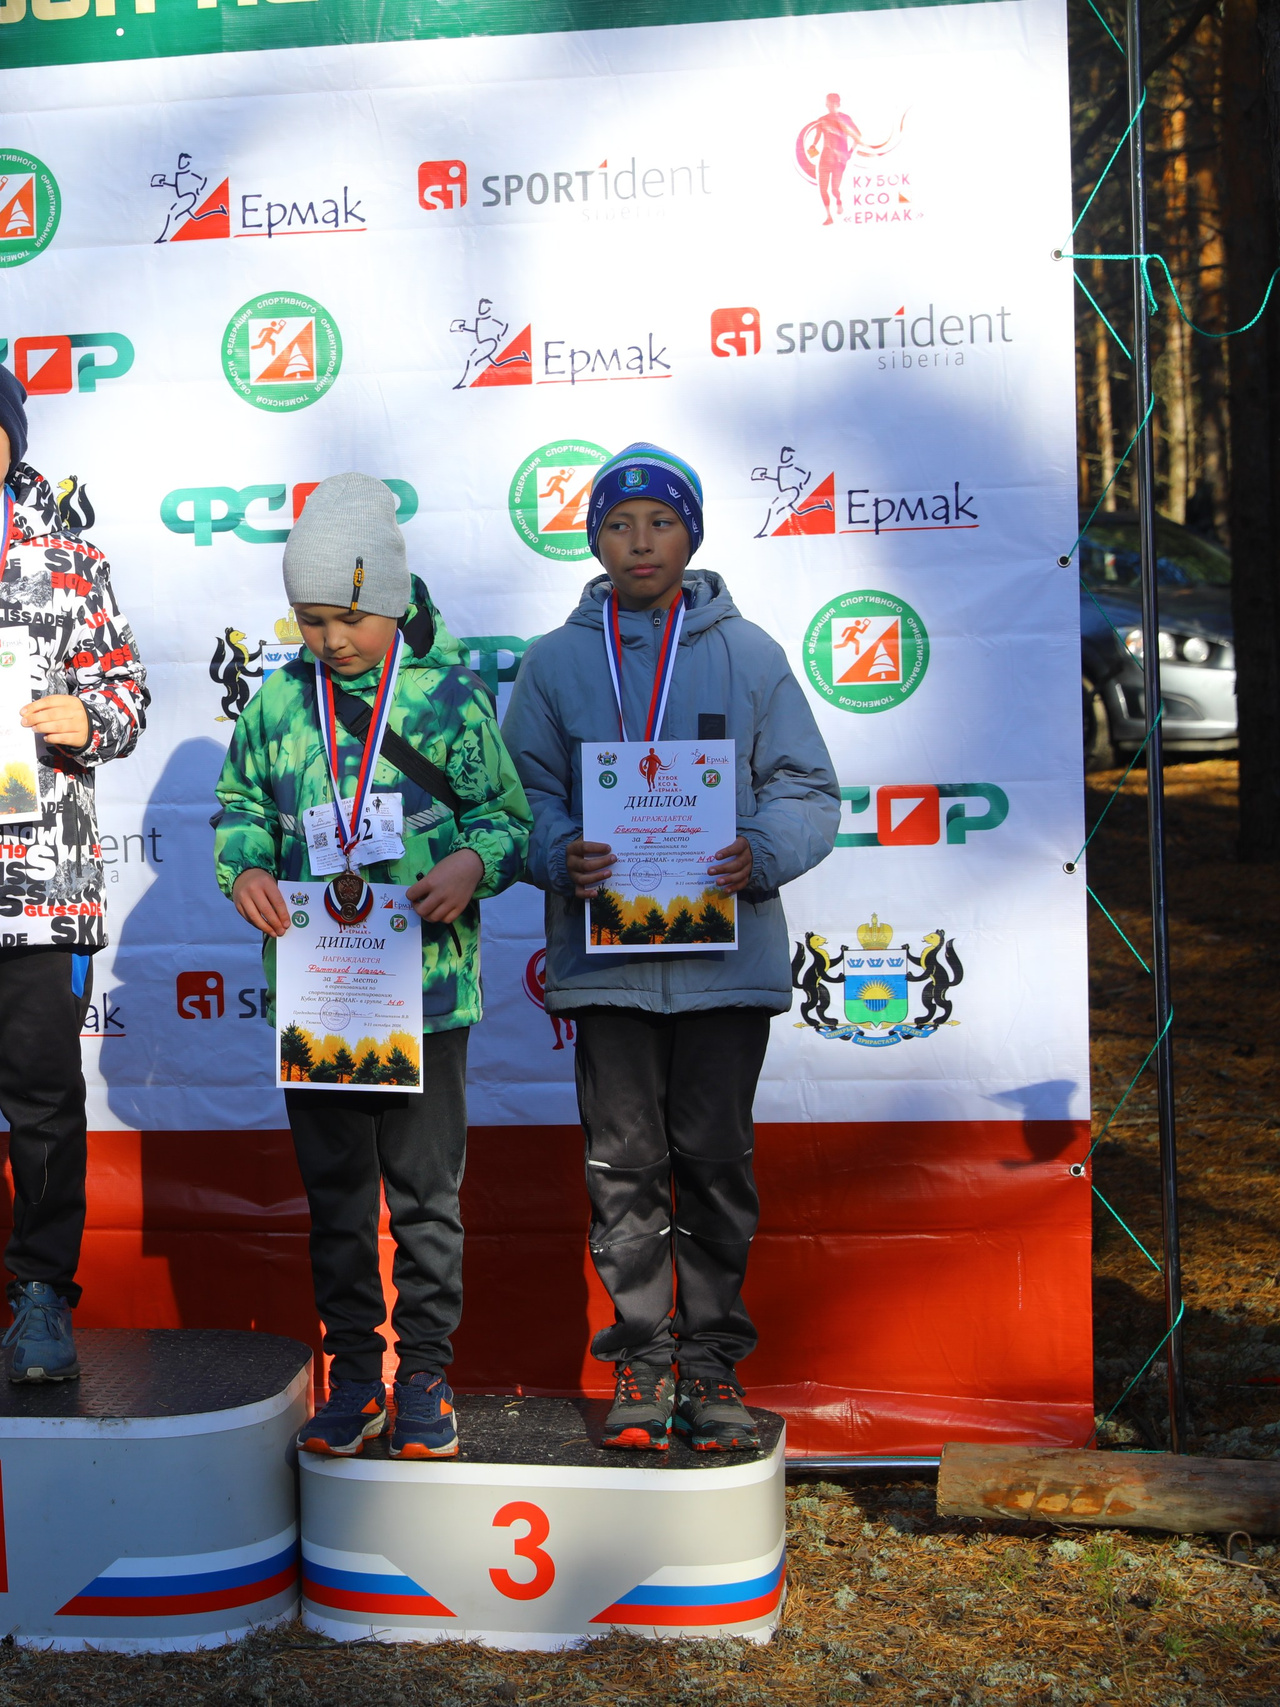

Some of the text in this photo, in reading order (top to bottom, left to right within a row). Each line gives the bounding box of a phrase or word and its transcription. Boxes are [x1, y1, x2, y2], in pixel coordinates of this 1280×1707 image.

[481, 157, 712, 208] SPORTident
[853, 173, 911, 189] КУБОК
[853, 192, 890, 206] КСО
[34, 174, 56, 248] ОРИЕНТИРОВАНИЯ
[240, 186, 367, 239] Ермак
[226, 296, 337, 407] ФЕДЕРАЦИЯ СПОРТИВНОГО ОРИЕНТИРОВАНИЯ ТЮМЕНСКОЙ ОБЛАСТИ
[775, 303, 1013, 356] SPORTident
[543, 332, 673, 385] Ермак
[878, 348, 965, 371] siberia
[514, 444, 607, 556] ФЕДЕРАЦИЯ СПОРТИВНОГО ЮМЕНСКОЙ ОБЛАСТИ
[846, 481, 979, 535] Ермак
[808, 595, 924, 708] ФЕДЕРАЦИЯ СПОРТИВНОГО ОРИЕНТИРОВАНИЯ ТЮМЕНСКОЙ ОБЛАСТИ
[706, 756, 730, 765] Ермак
[623, 795, 698, 810] ДИПЛОМ
[630, 815, 693, 823] НАГРАЖДАЕТСЯ
[23, 902, 103, 918] GLISSADE
[315, 936, 387, 950] ДИПЛОМ
[322, 955, 381, 964] НАГРАЖДАЕТСЯ
[490, 1501, 556, 1602] 3
